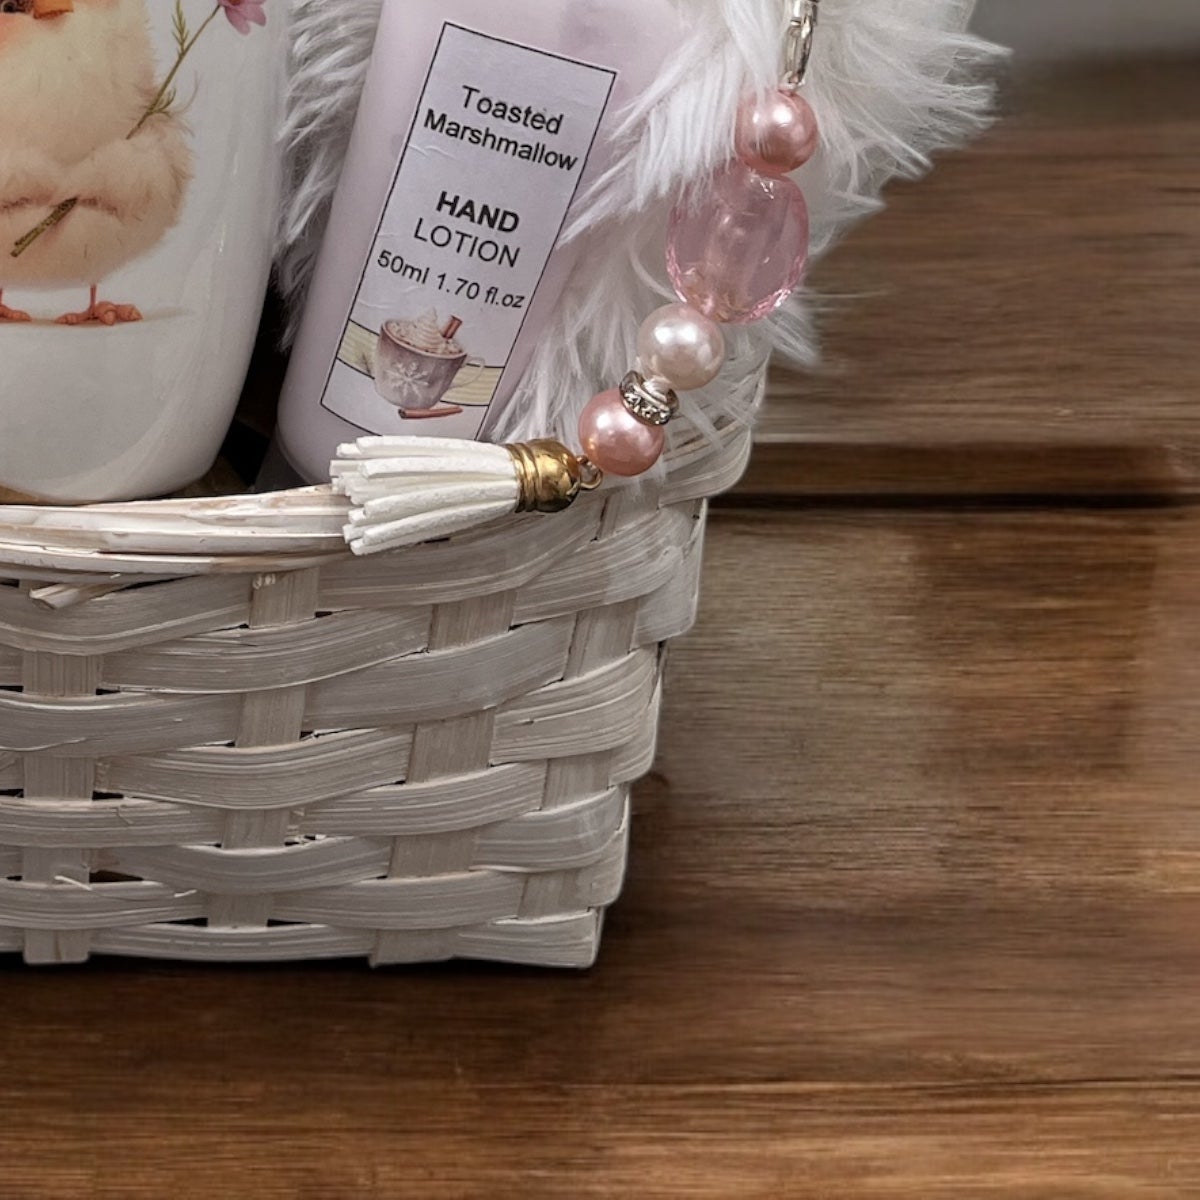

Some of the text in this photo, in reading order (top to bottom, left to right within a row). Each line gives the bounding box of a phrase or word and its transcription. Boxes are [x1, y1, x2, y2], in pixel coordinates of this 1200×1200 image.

[462, 84, 564, 136] Toasted
[423, 108, 579, 172] Marshmallow
[435, 190, 520, 234] HAND
[413, 217, 521, 269] LOTION
[377, 249, 526, 310] 50ml 1.70 fl.oz
